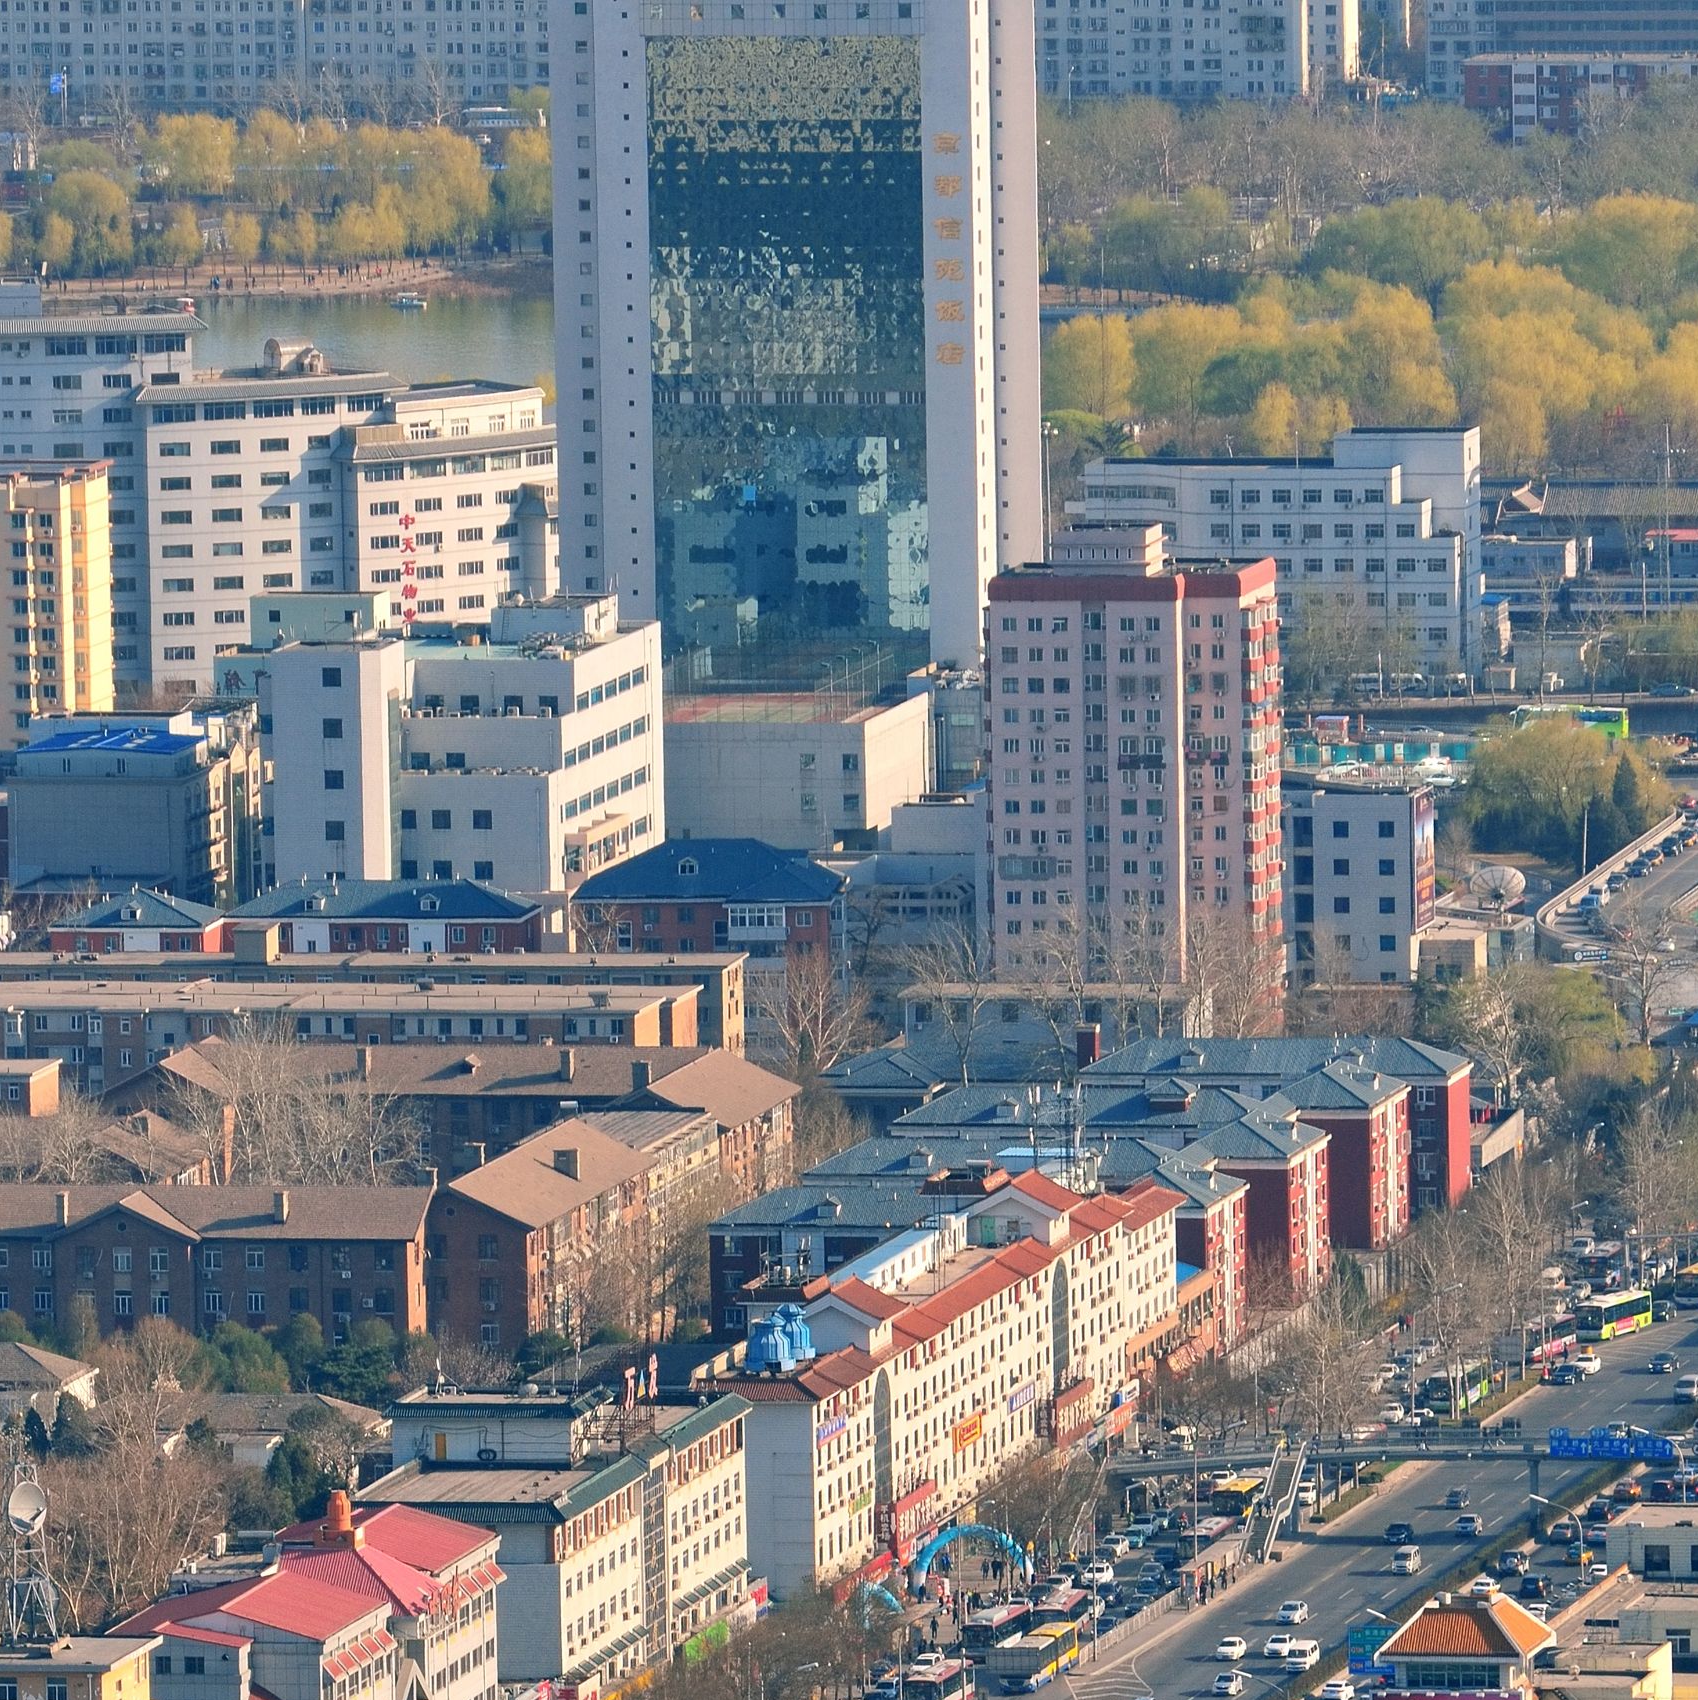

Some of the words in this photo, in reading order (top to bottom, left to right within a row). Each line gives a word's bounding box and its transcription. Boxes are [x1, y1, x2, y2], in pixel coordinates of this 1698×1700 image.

[932, 133, 965, 364] 京都信苑饭店
